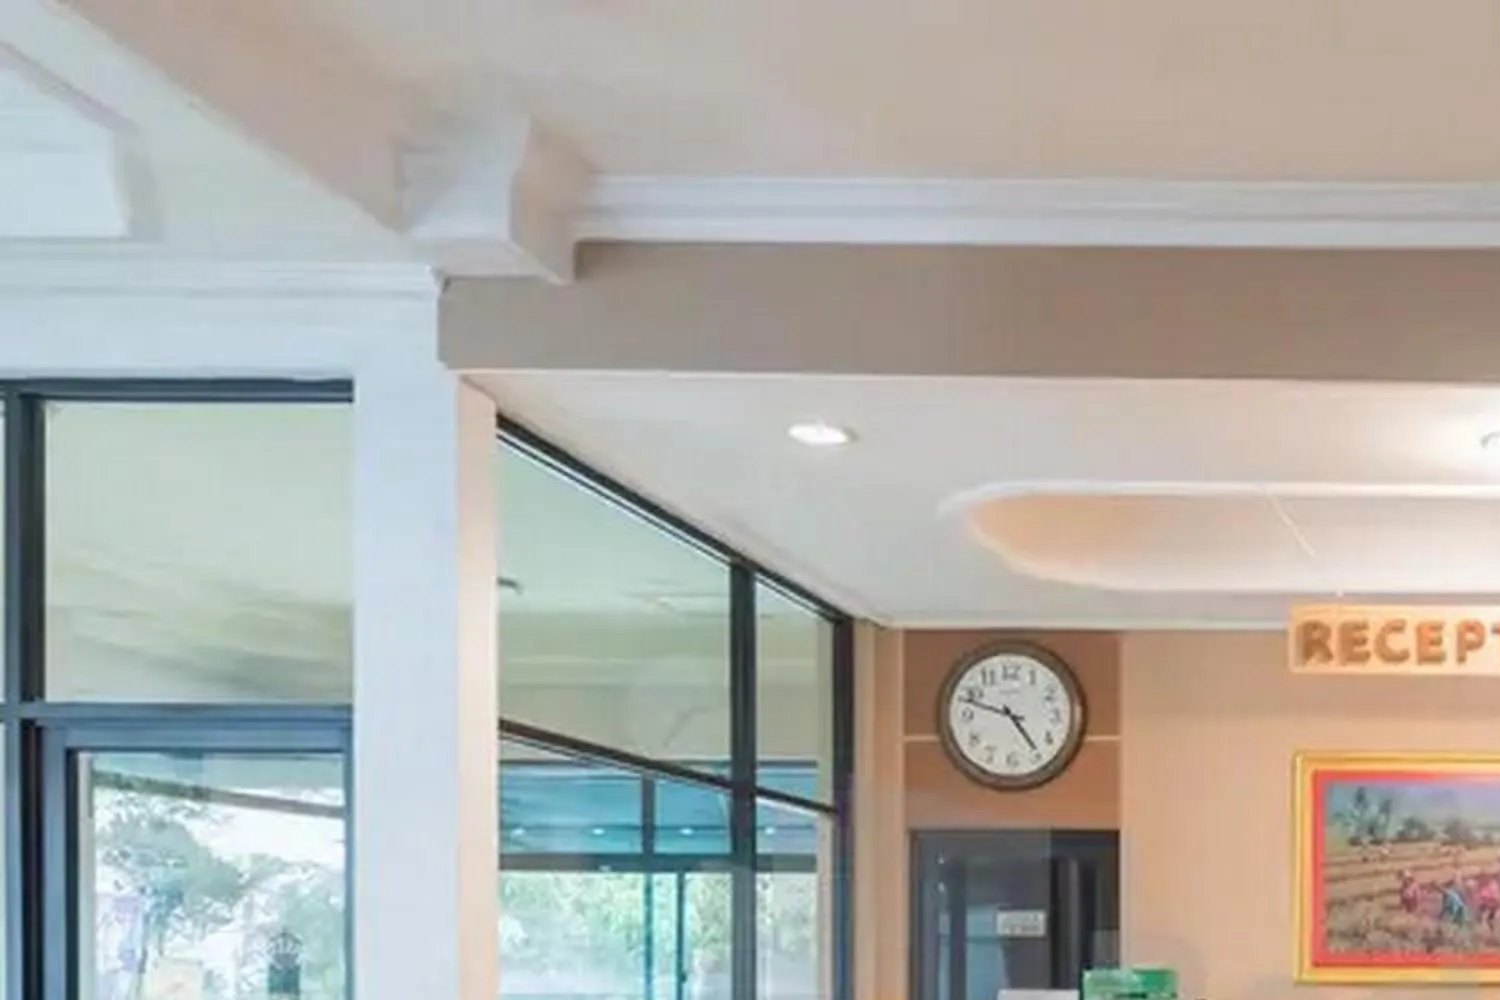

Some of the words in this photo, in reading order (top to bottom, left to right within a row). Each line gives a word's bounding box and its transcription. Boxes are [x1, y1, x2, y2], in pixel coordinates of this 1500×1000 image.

[981, 667, 996, 686] 11
[1002, 664, 1021, 681] 12
[1029, 669, 1037, 686] 1
[961, 708, 975, 723] 9
[1006, 751, 1020, 768] 6
